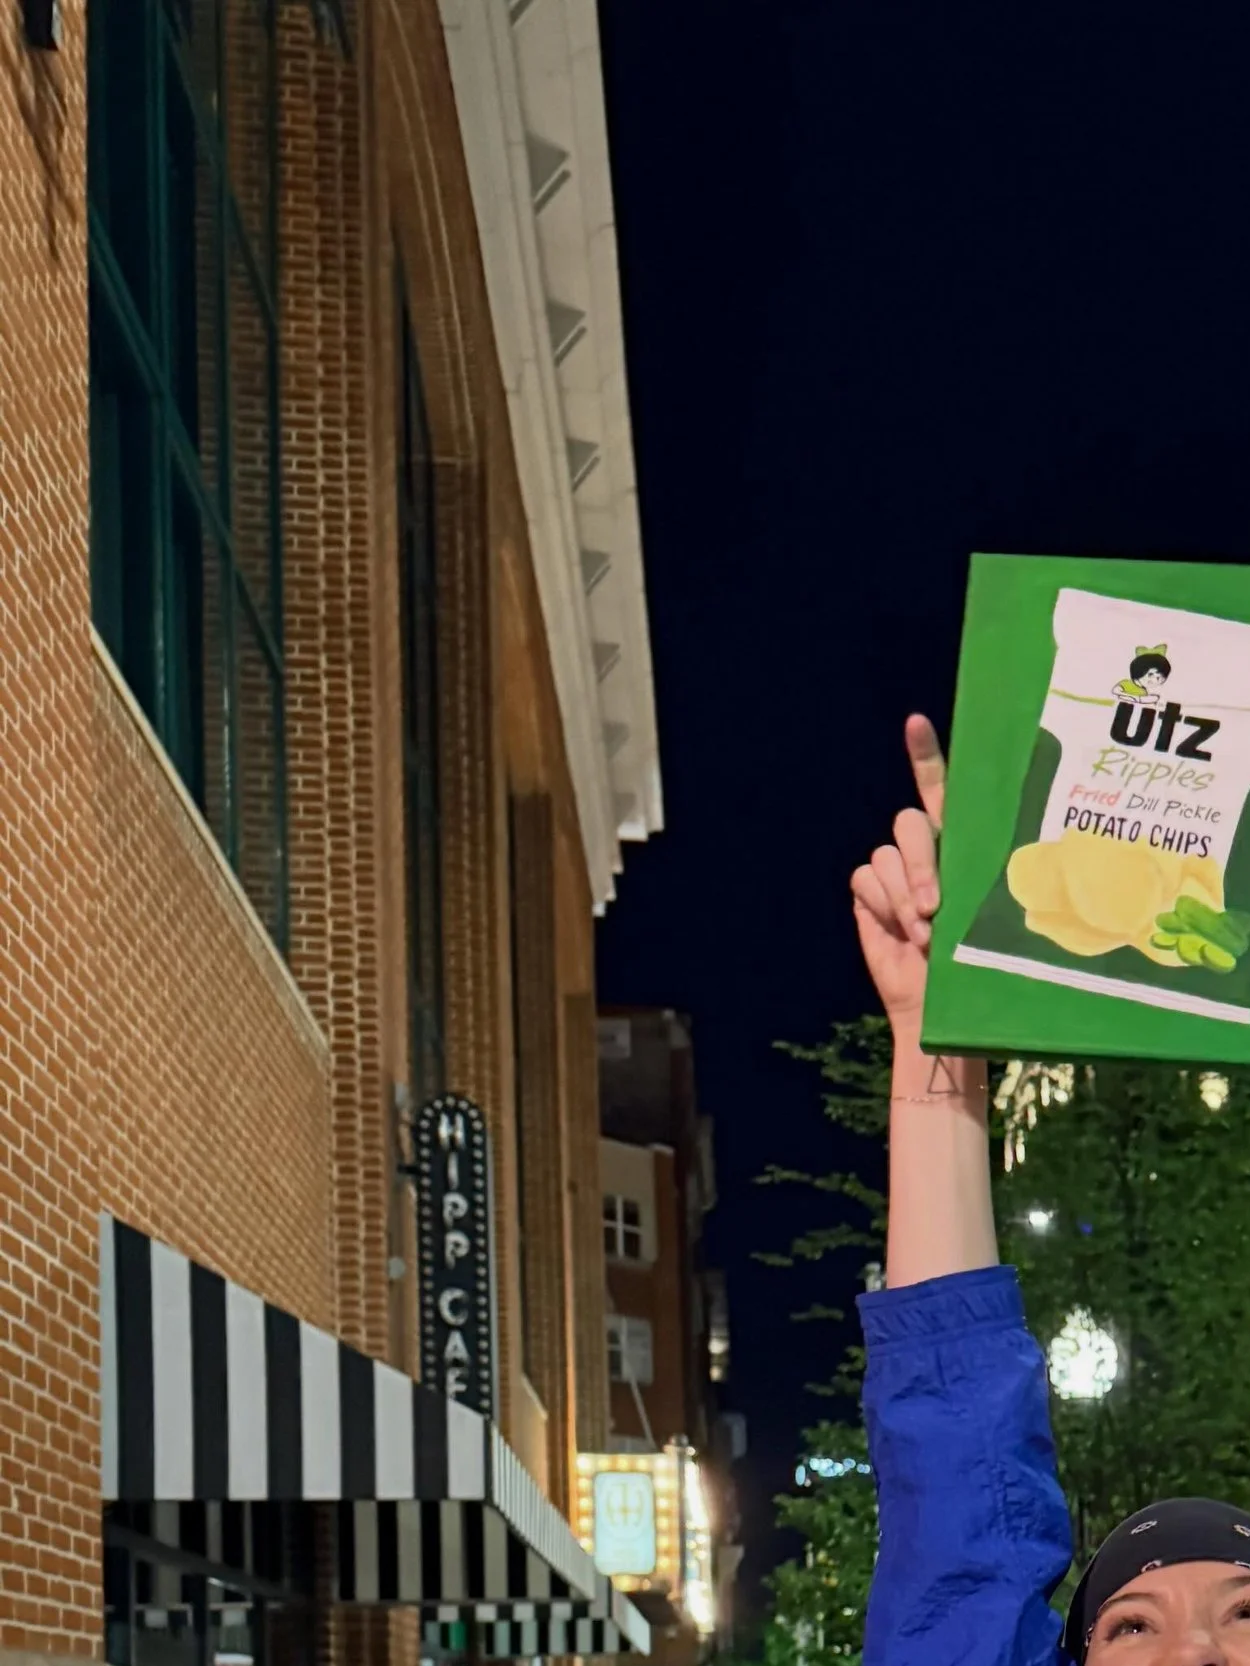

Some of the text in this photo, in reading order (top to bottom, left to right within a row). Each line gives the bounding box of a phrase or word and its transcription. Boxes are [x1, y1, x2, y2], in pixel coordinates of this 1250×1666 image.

[1091, 746, 1215, 791] Ripples
[1064, 806, 1212, 858] POTATO CHIPS
[1126, 793, 1160, 811] Dill
[1163, 800, 1221, 823] Pickle
[437, 1111, 472, 1270] HIPP
[438, 1287, 471, 1402] CAF
